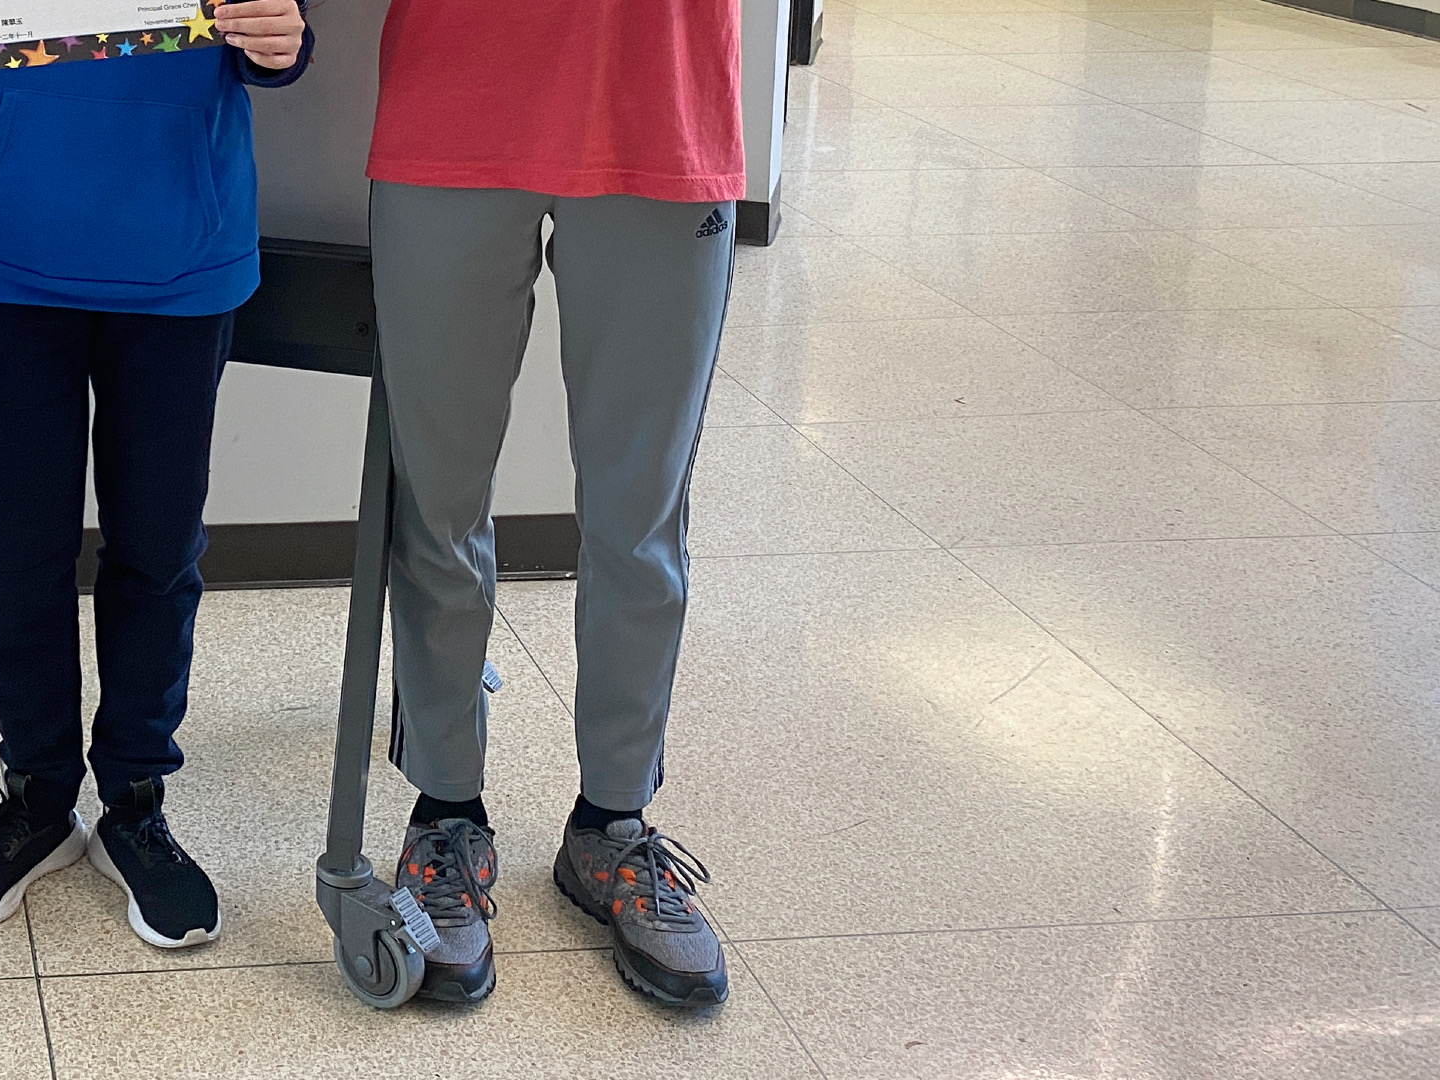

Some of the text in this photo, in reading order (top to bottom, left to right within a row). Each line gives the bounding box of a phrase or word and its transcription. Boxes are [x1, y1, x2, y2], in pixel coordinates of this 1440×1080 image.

[137, 4, 163, 13] Principal
[164, 3, 182, 11] Grace
[696, 220, 728, 238] adidas
